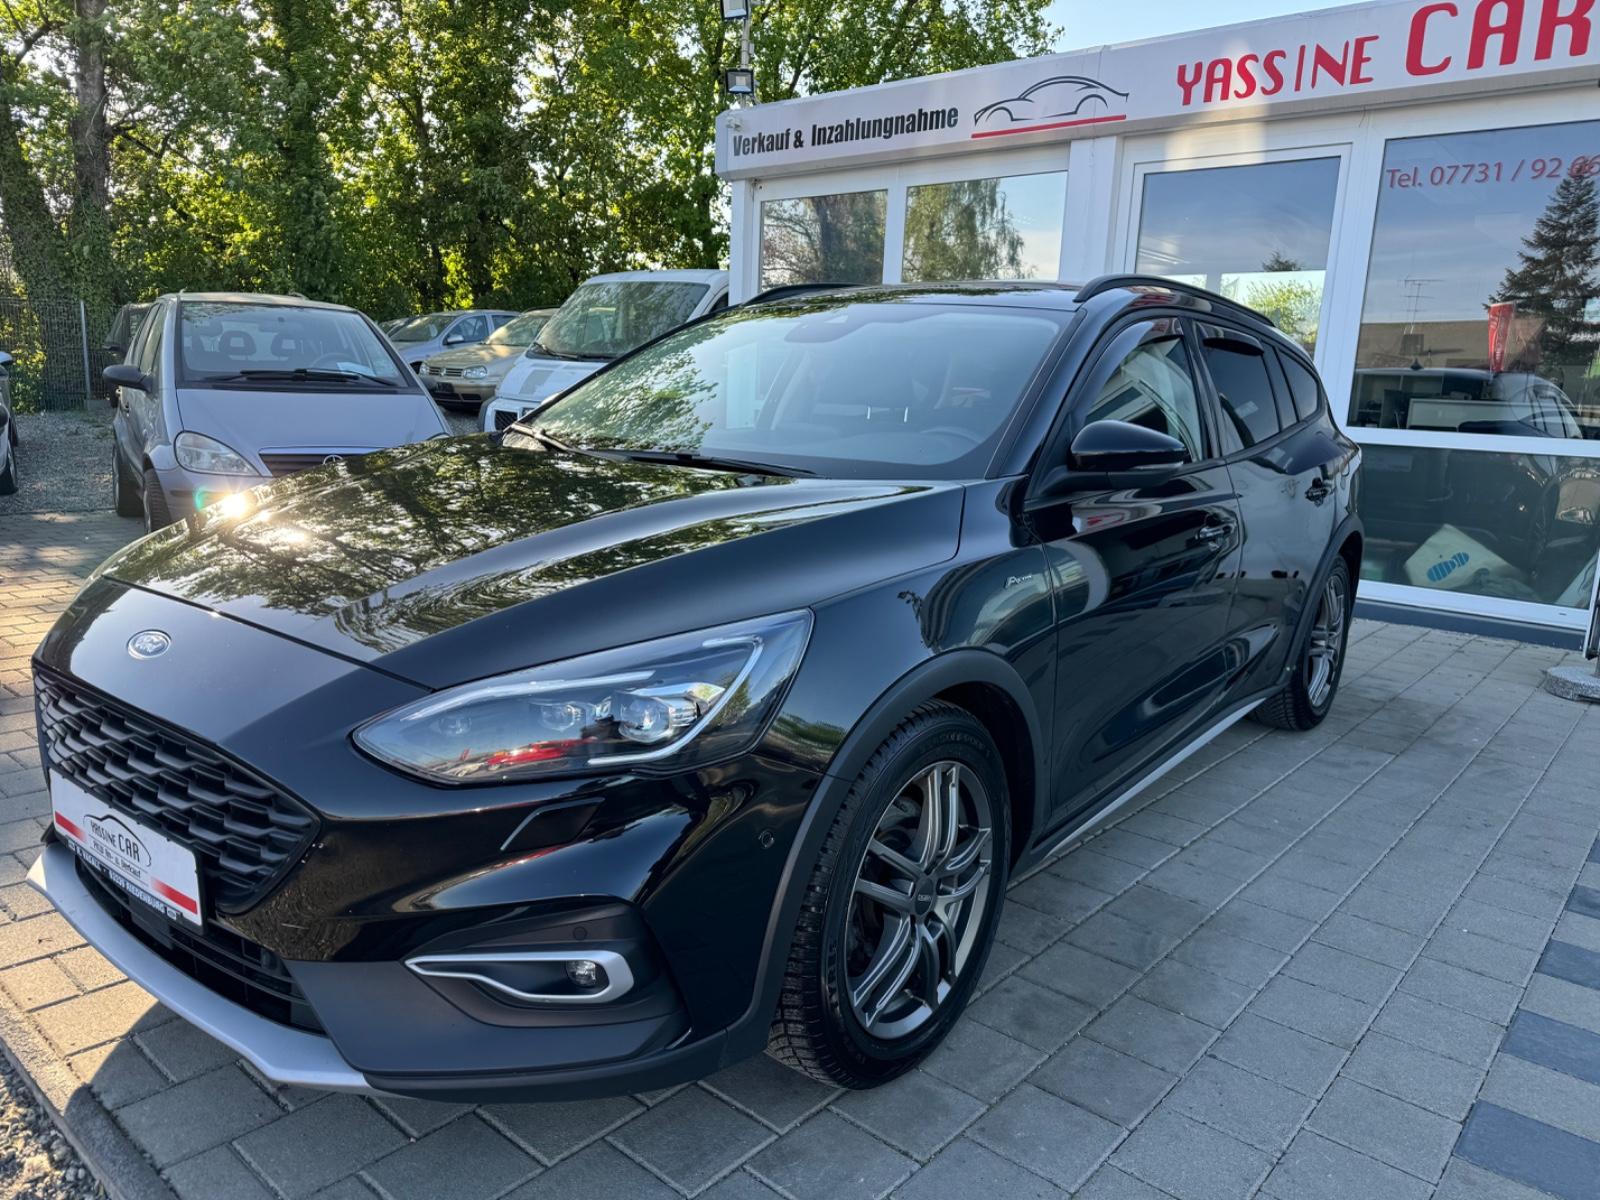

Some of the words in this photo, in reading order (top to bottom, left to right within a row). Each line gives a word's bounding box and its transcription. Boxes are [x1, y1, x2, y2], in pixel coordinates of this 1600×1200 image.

[1177, 35, 1380, 106] YASSINE
[1406, 0, 1596, 76] CAR
[733, 128, 791, 157] Verkauf
[793, 129, 804, 149] &
[811, 107, 959, 147] Inzahlungnahme
[1386, 166, 1422, 188] Tel.
[1430, 162, 1503, 186] 07731
[1531, 157, 1562, 180] 92
[118, 834, 140, 862] CAR
